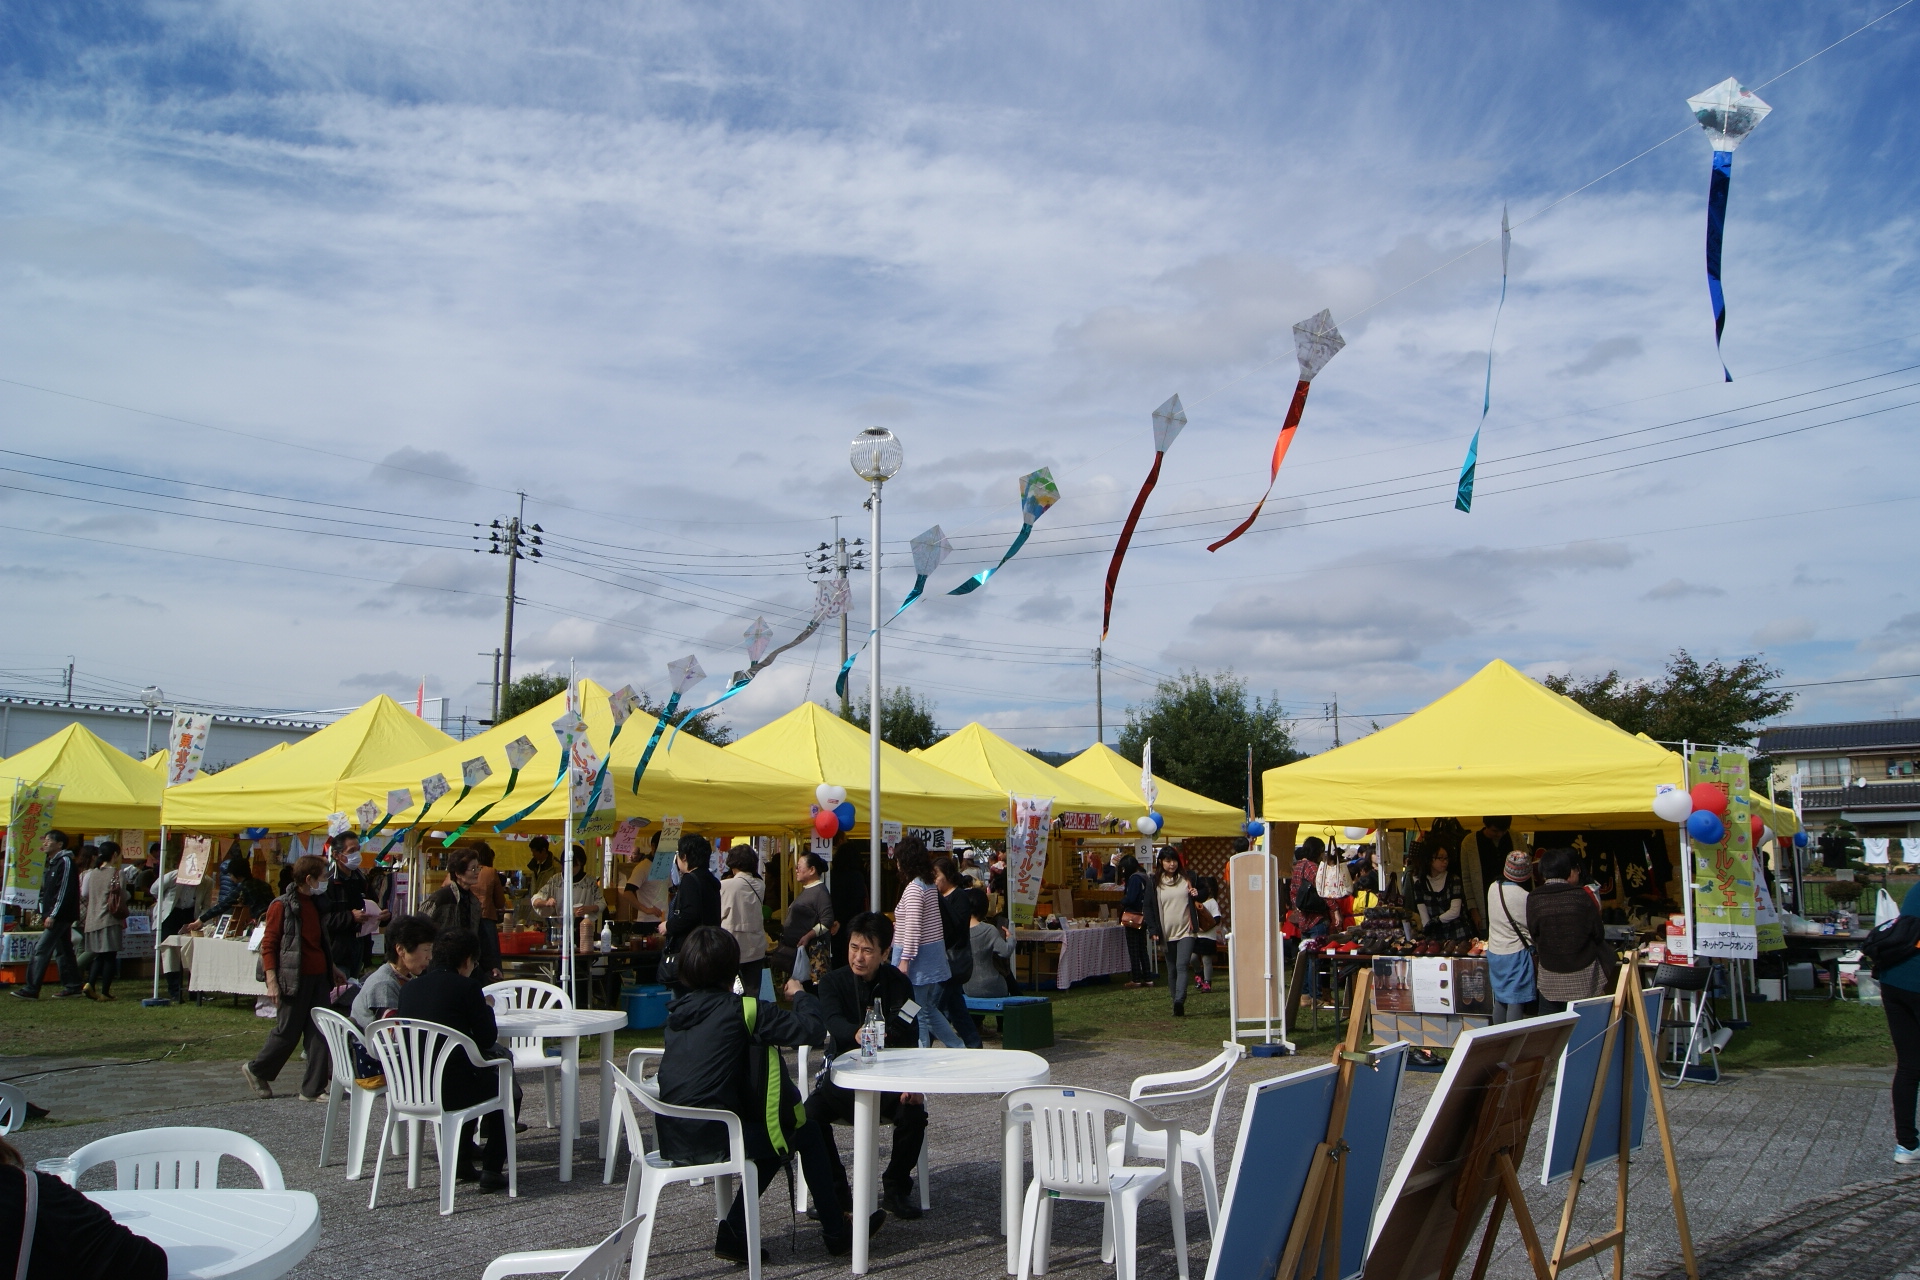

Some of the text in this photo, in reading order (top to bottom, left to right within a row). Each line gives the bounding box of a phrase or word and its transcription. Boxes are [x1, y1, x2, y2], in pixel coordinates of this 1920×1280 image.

[1065, 813, 1100, 829] PEACE JAM
[816, 837, 830, 849] 10
[1140, 845, 1148, 855] 8
[1702, 940, 1754, 951] ネットワークオレンジ
